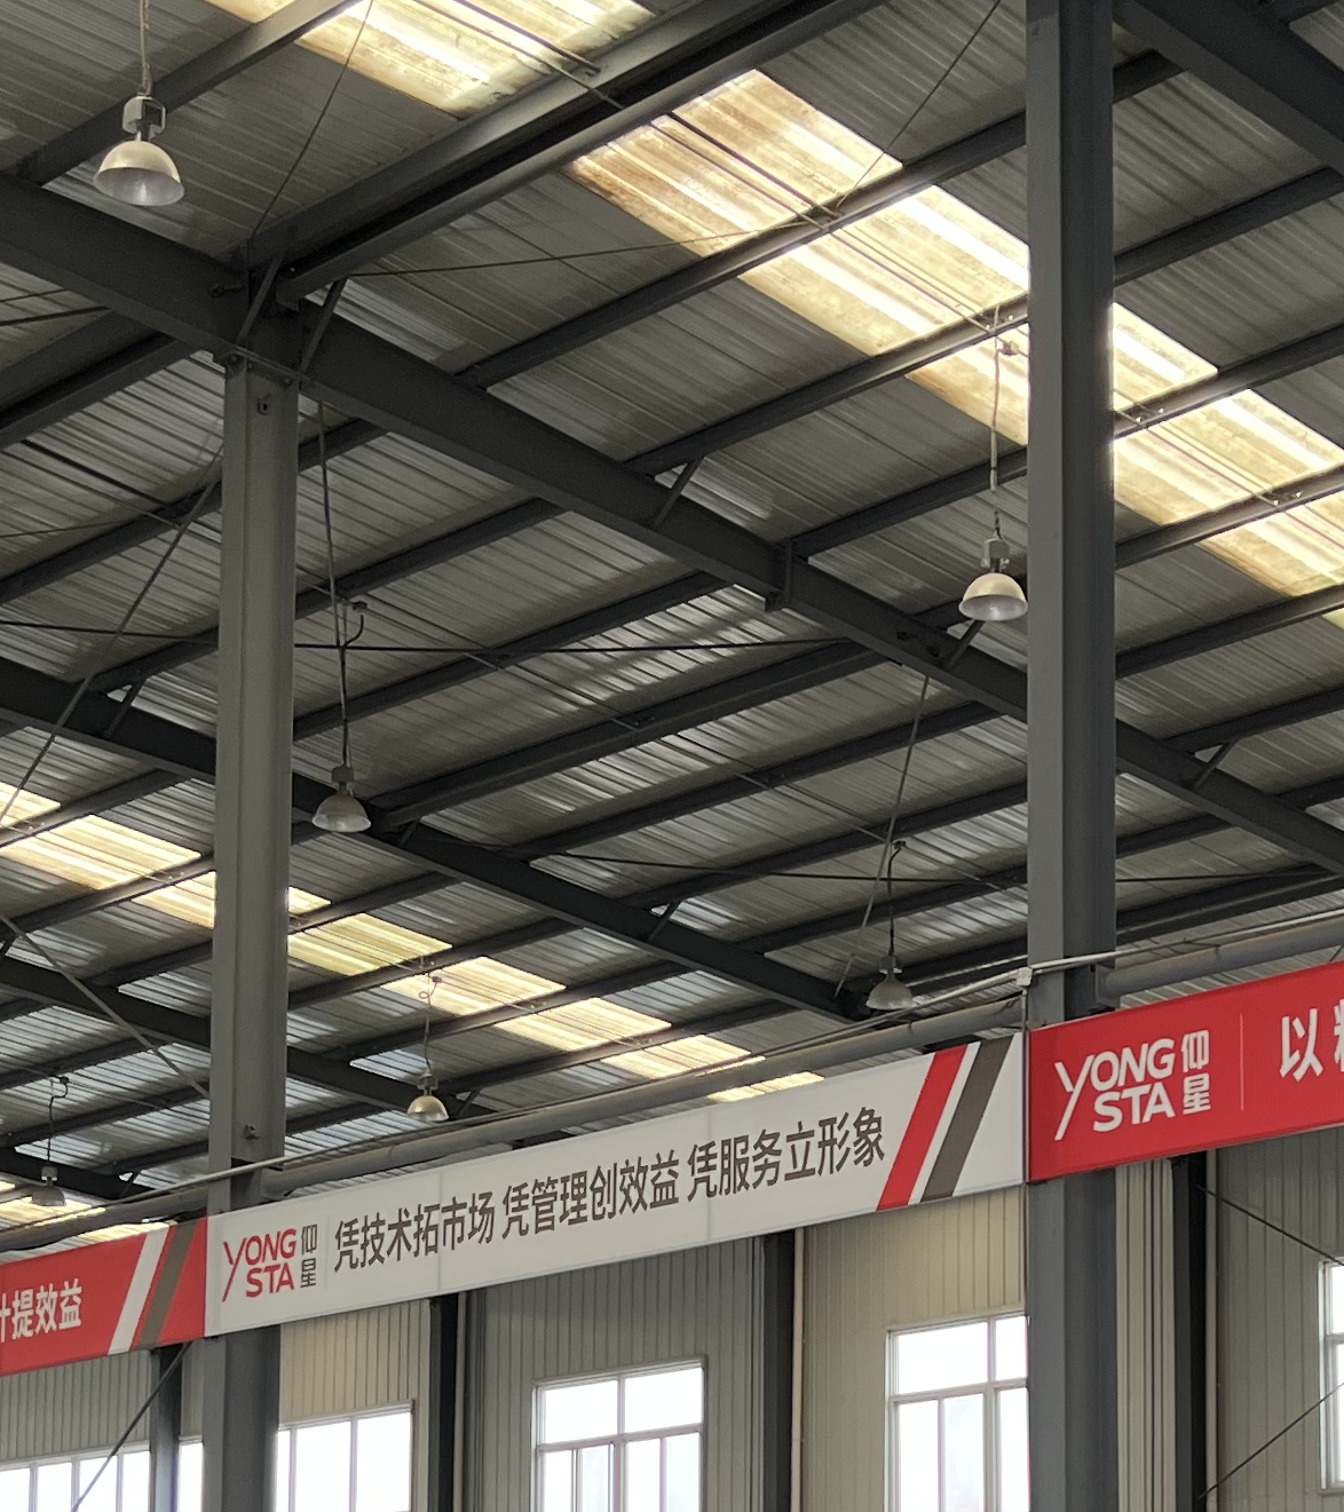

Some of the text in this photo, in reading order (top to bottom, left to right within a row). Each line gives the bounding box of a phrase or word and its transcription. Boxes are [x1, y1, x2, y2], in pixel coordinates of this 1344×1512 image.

[1054, 1036, 1176, 1140] YONG
[1093, 1081, 1174, 1133] STA
[1181, 1029, 1211, 1116] 仰星
[334, 1107, 886, 1273] 凭技术拓市场 凭管理创效益 凭服务立形象
[222, 1228, 297, 1299] YONG
[246, 1264, 295, 1296] STA
[299, 1225, 319, 1289] 仰星
